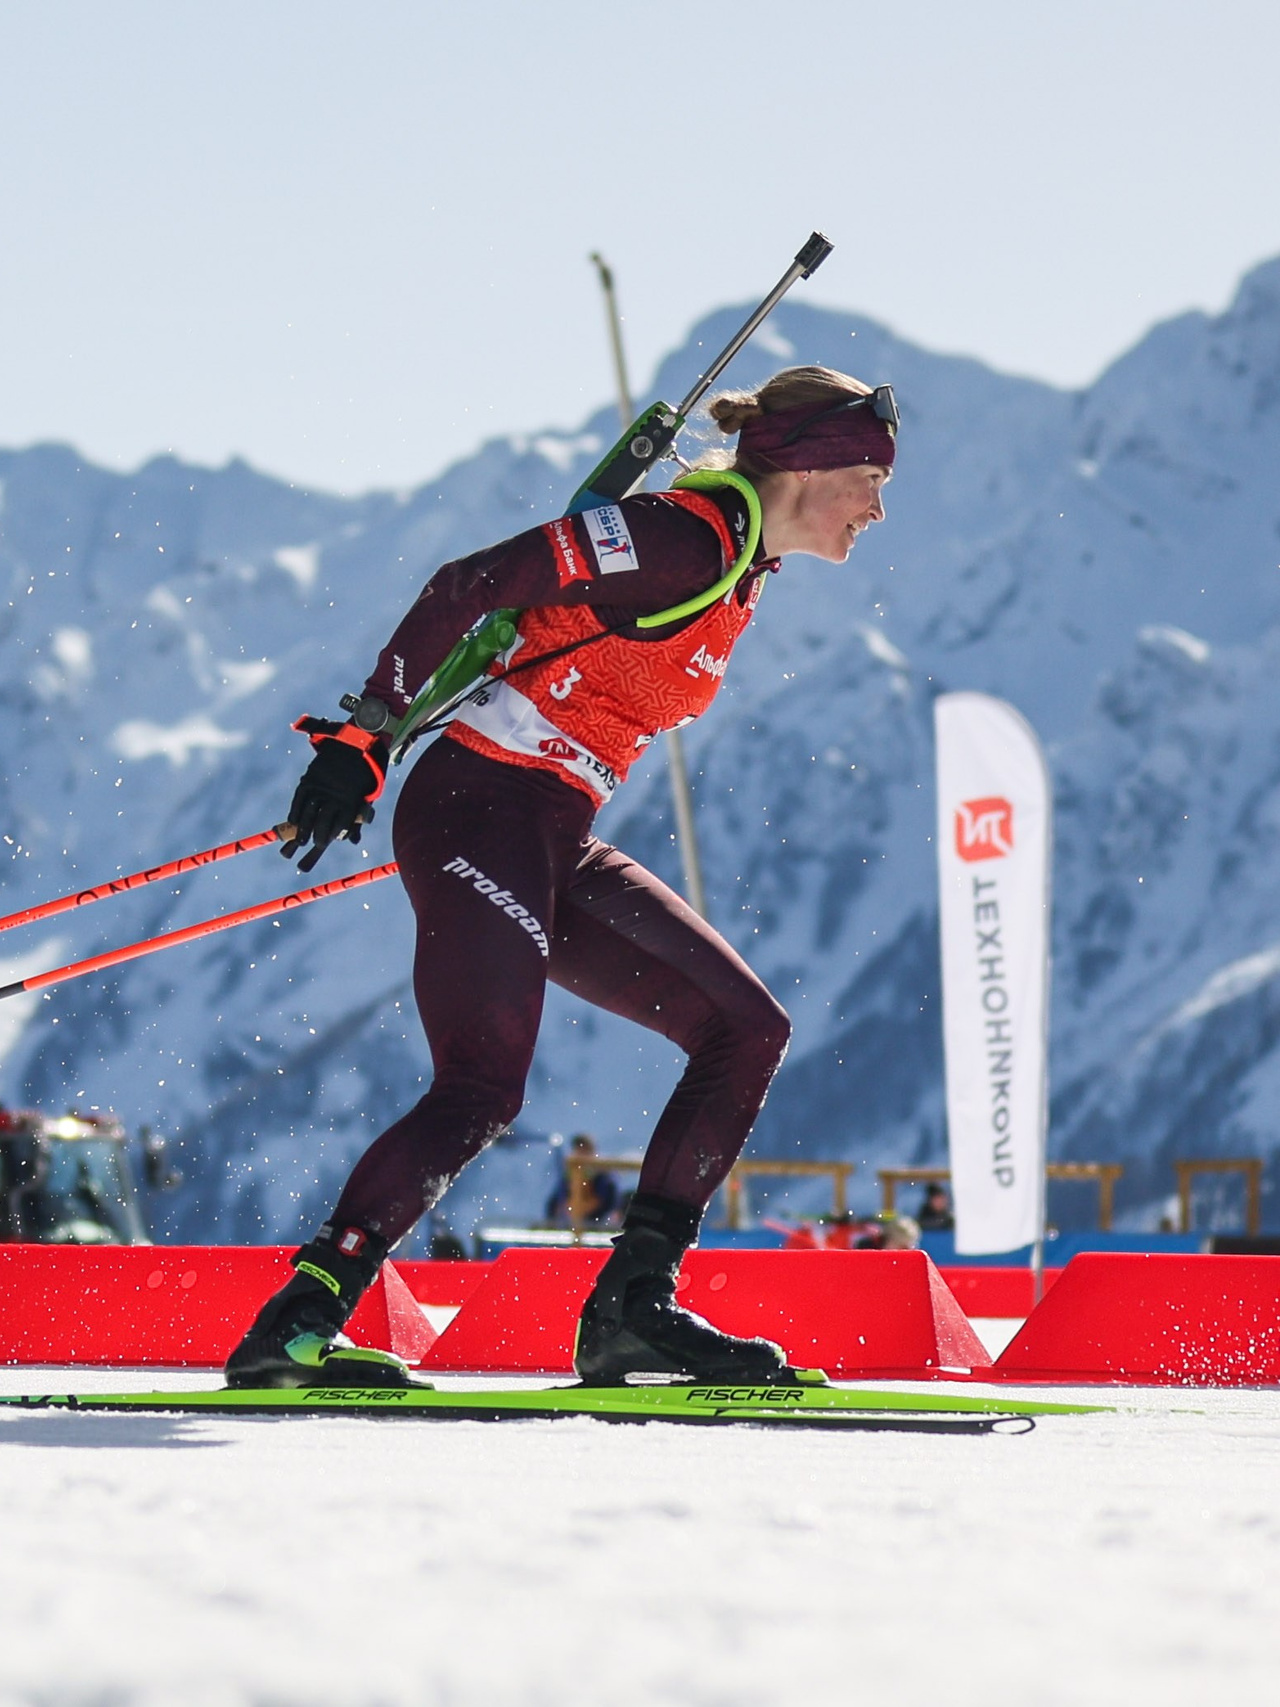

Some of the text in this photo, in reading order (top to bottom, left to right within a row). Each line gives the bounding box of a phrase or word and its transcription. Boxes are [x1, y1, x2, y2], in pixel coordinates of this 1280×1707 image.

[597, 508, 615, 536] СБР
[563, 548, 578, 576] Банк
[550, 666, 582, 700] 3
[303, 1390, 408, 1401] FISCHER
[686, 1389, 804, 1401] FISCHER
